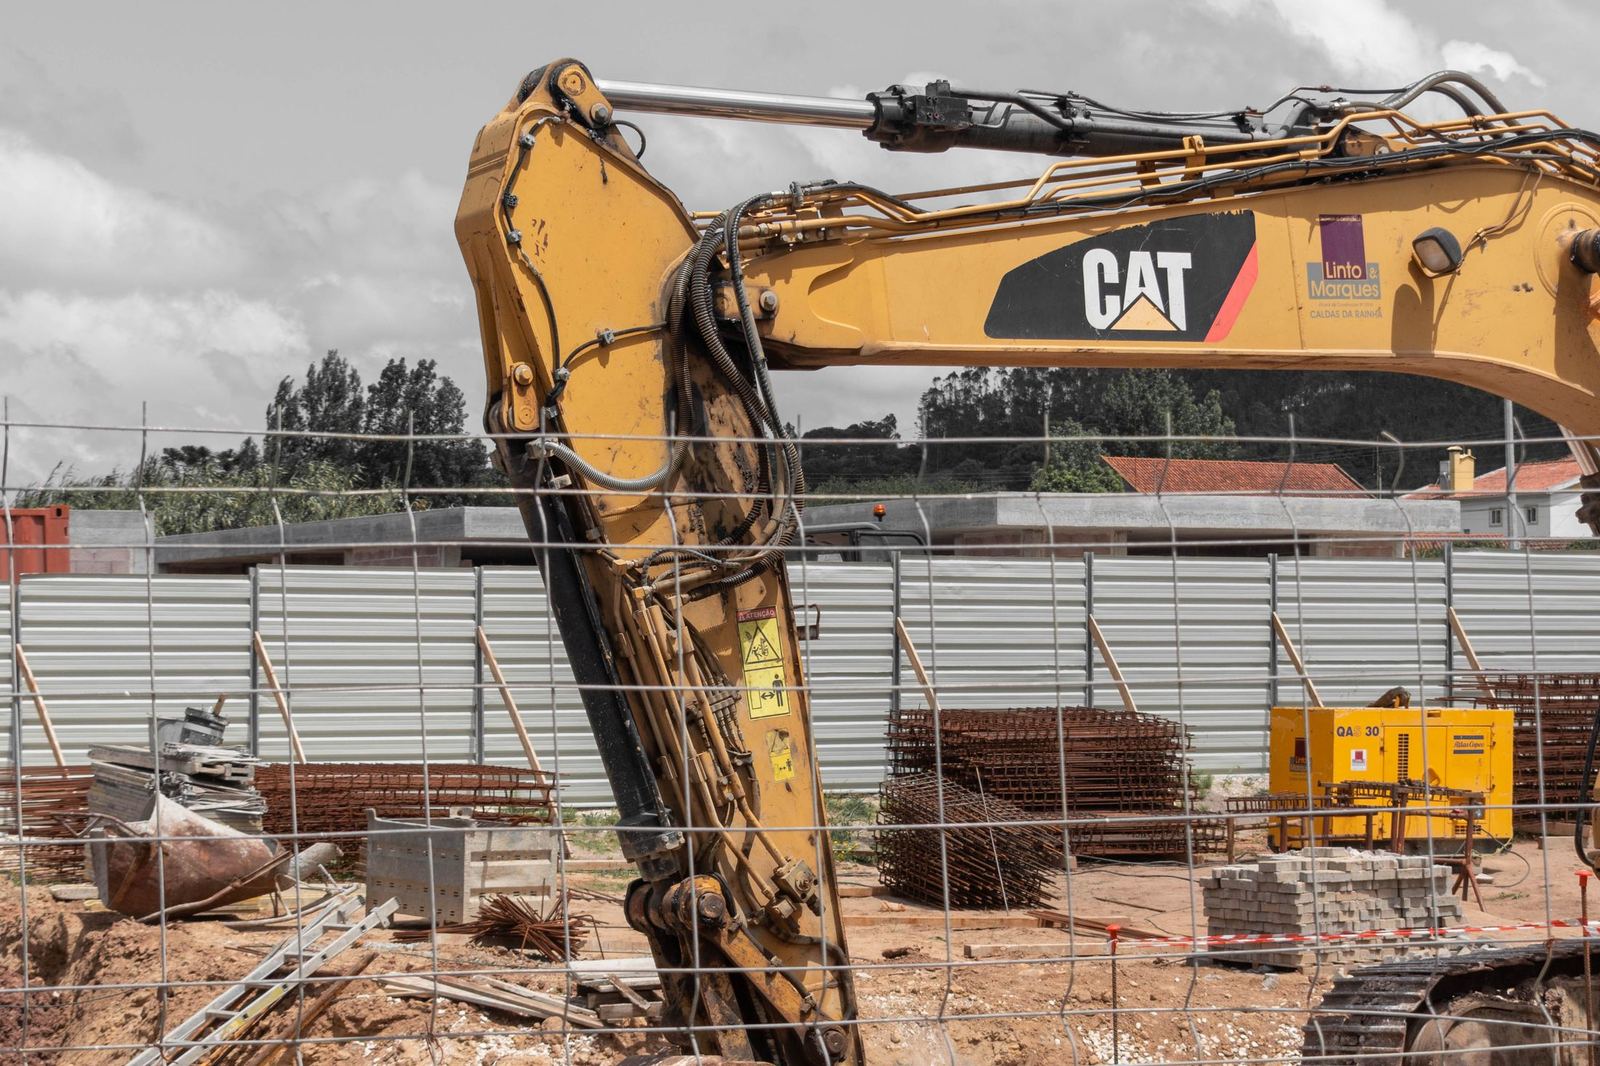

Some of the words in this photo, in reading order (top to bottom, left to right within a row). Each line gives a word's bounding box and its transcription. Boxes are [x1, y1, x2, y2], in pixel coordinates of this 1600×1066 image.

[1325, 261, 1362, 279] Linto
[1369, 267, 1378, 280] &
[1082, 248, 1192, 331] CAT
[1311, 280, 1379, 299] Marques
[1311, 310, 1340, 319] CALDAS
[1342, 310, 1354, 318] DA
[745, 608, 775, 619] ATENÇÃO
[1365, 726, 1380, 737] 30
